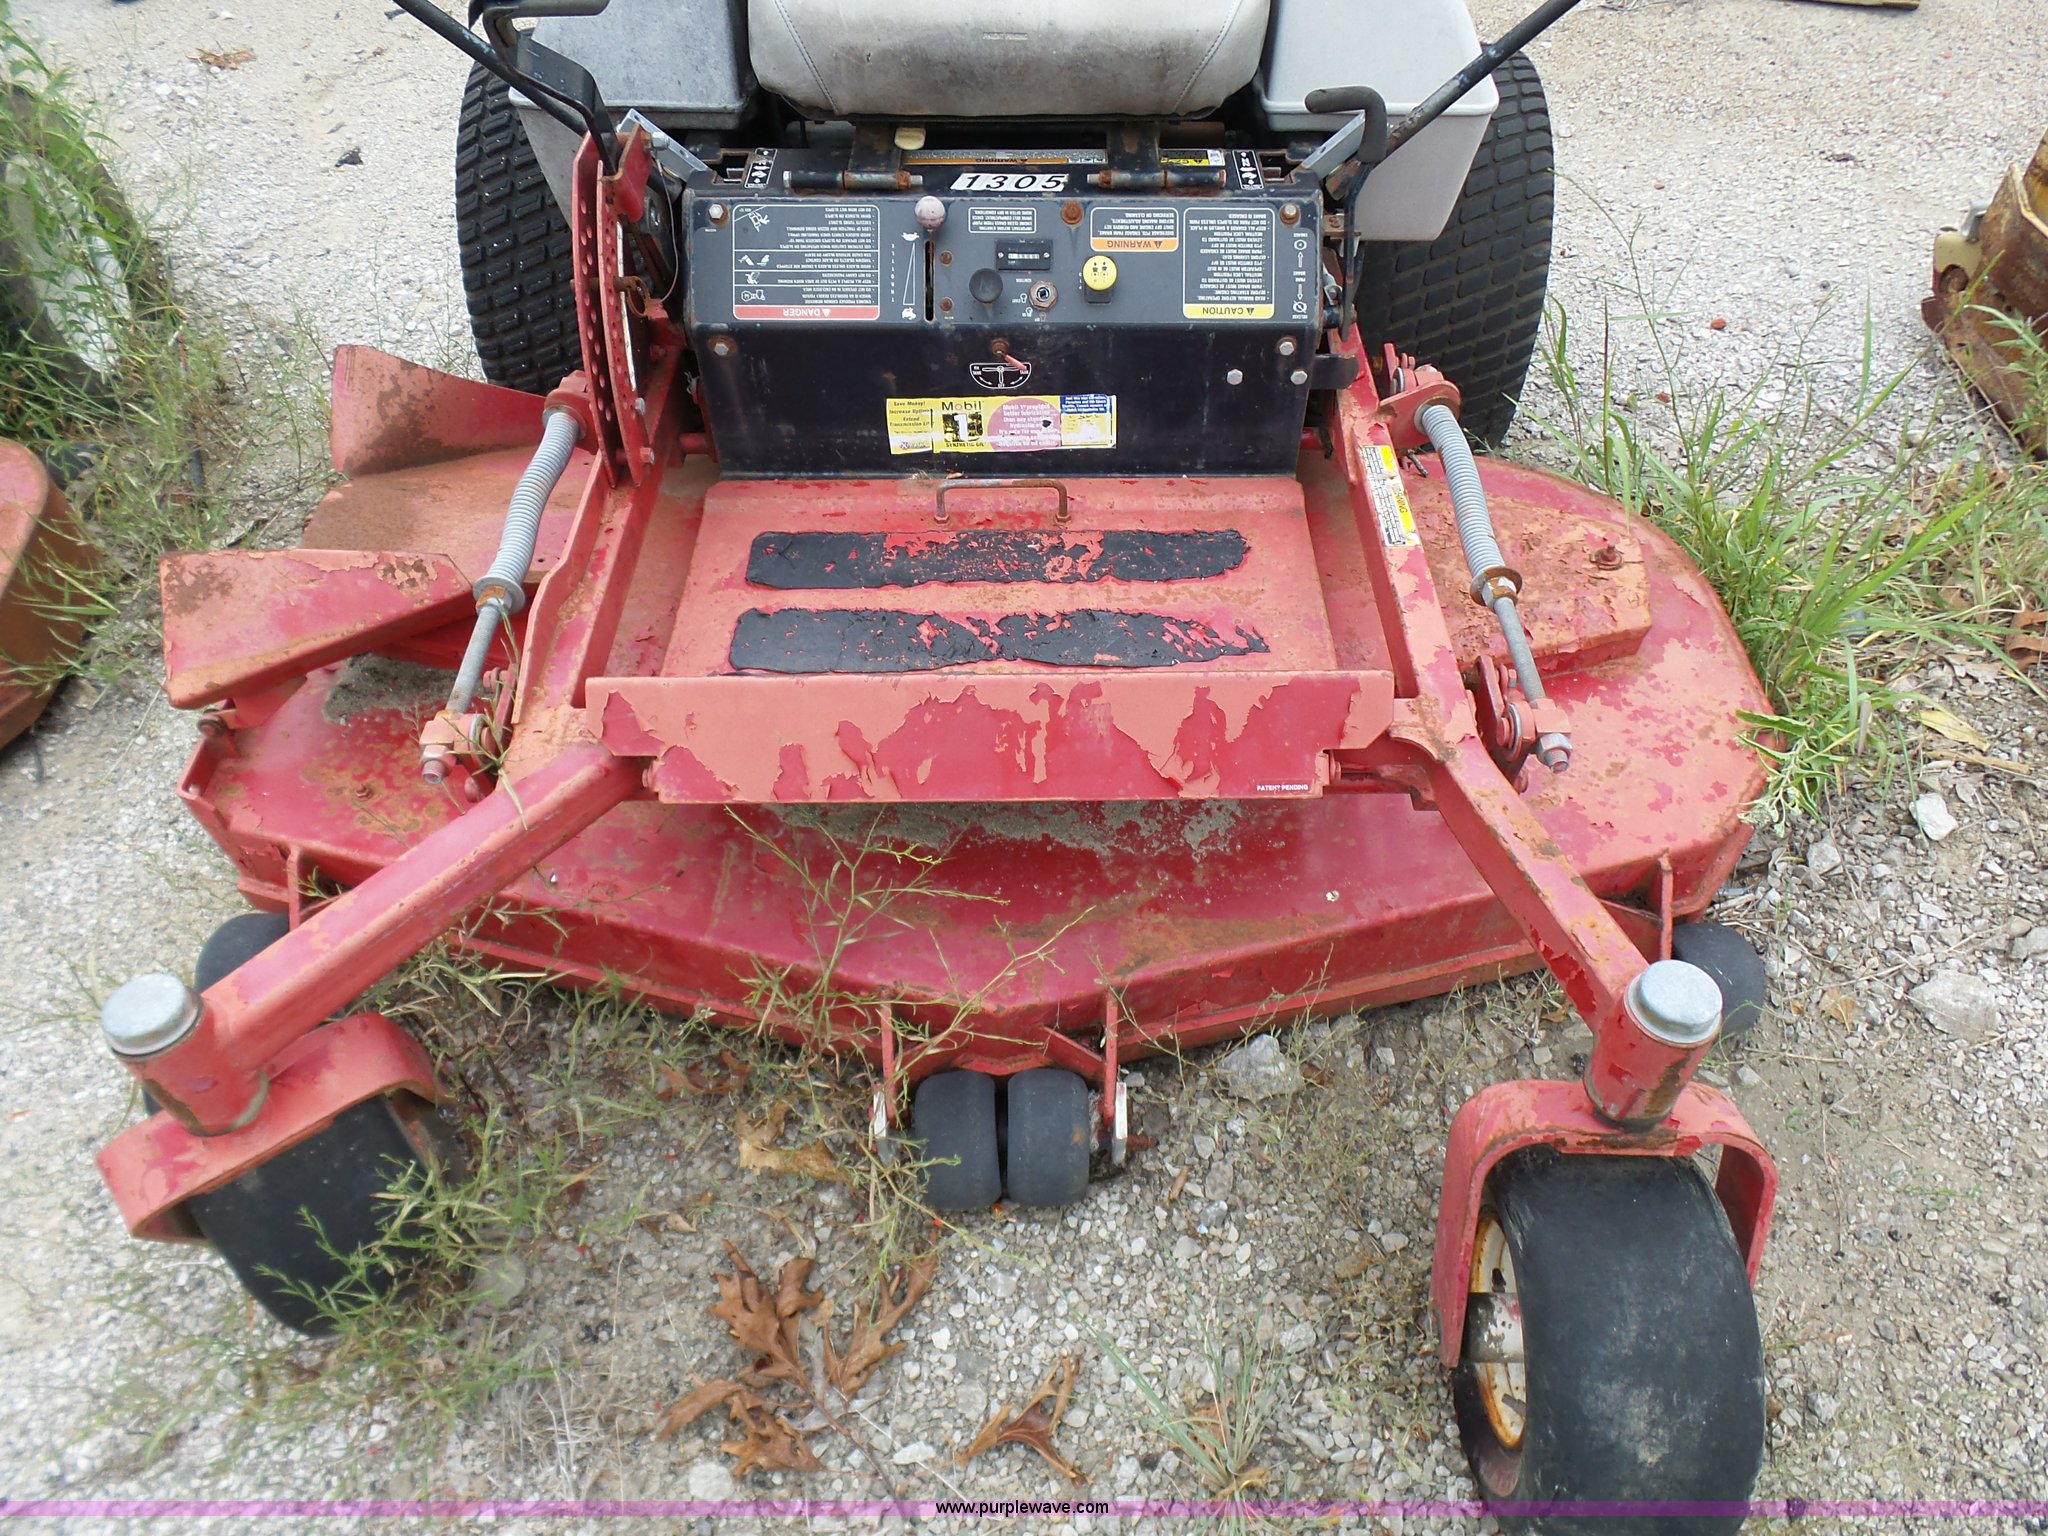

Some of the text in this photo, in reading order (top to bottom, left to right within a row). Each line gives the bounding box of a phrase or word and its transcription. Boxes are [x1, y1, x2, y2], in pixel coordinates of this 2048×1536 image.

[966, 175, 1065, 189] 1305
[782, 308, 820, 316] DANGER
[942, 401, 981, 411] Mobil
[954, 414, 968, 442] 1
